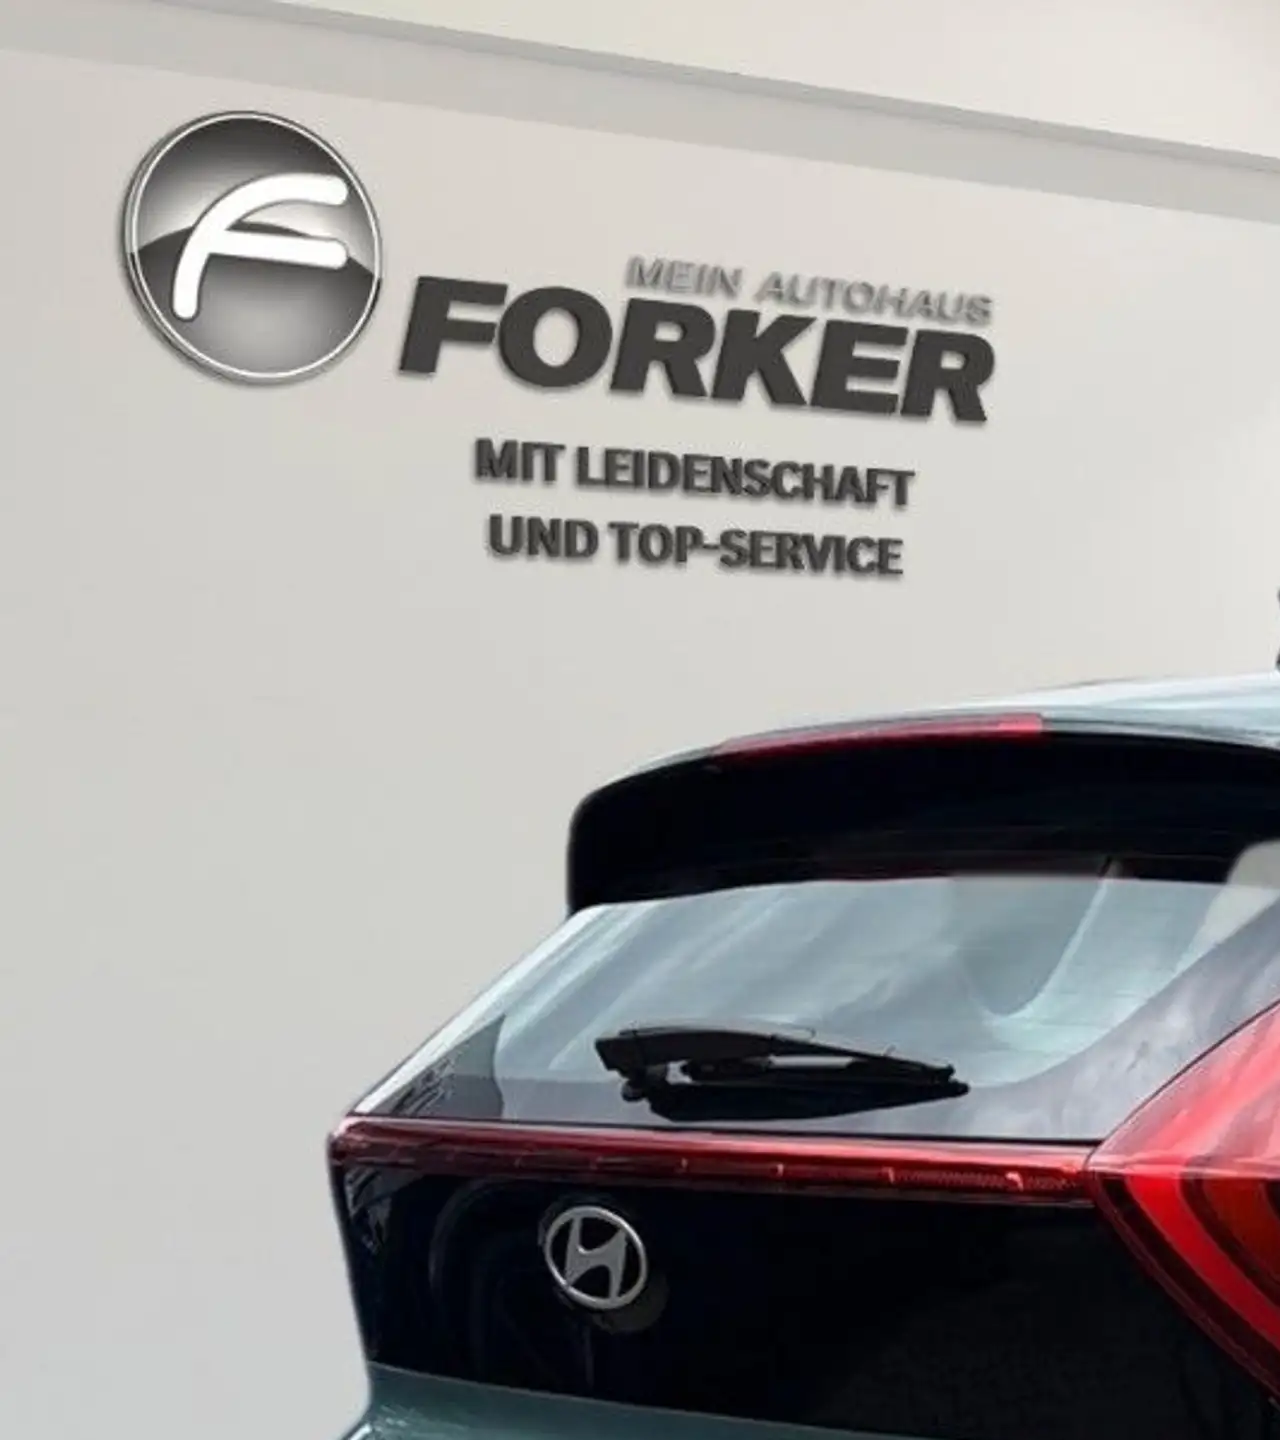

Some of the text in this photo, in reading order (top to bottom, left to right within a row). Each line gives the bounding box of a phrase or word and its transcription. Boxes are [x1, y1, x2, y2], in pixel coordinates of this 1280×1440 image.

[626, 256, 994, 327] MEIN AUTOHAUS
[399, 275, 996, 424] FORKER
[474, 437, 916, 508] MIT LEIDENSCHAFT
[488, 513, 904, 577] UND TOP-SERVICE
